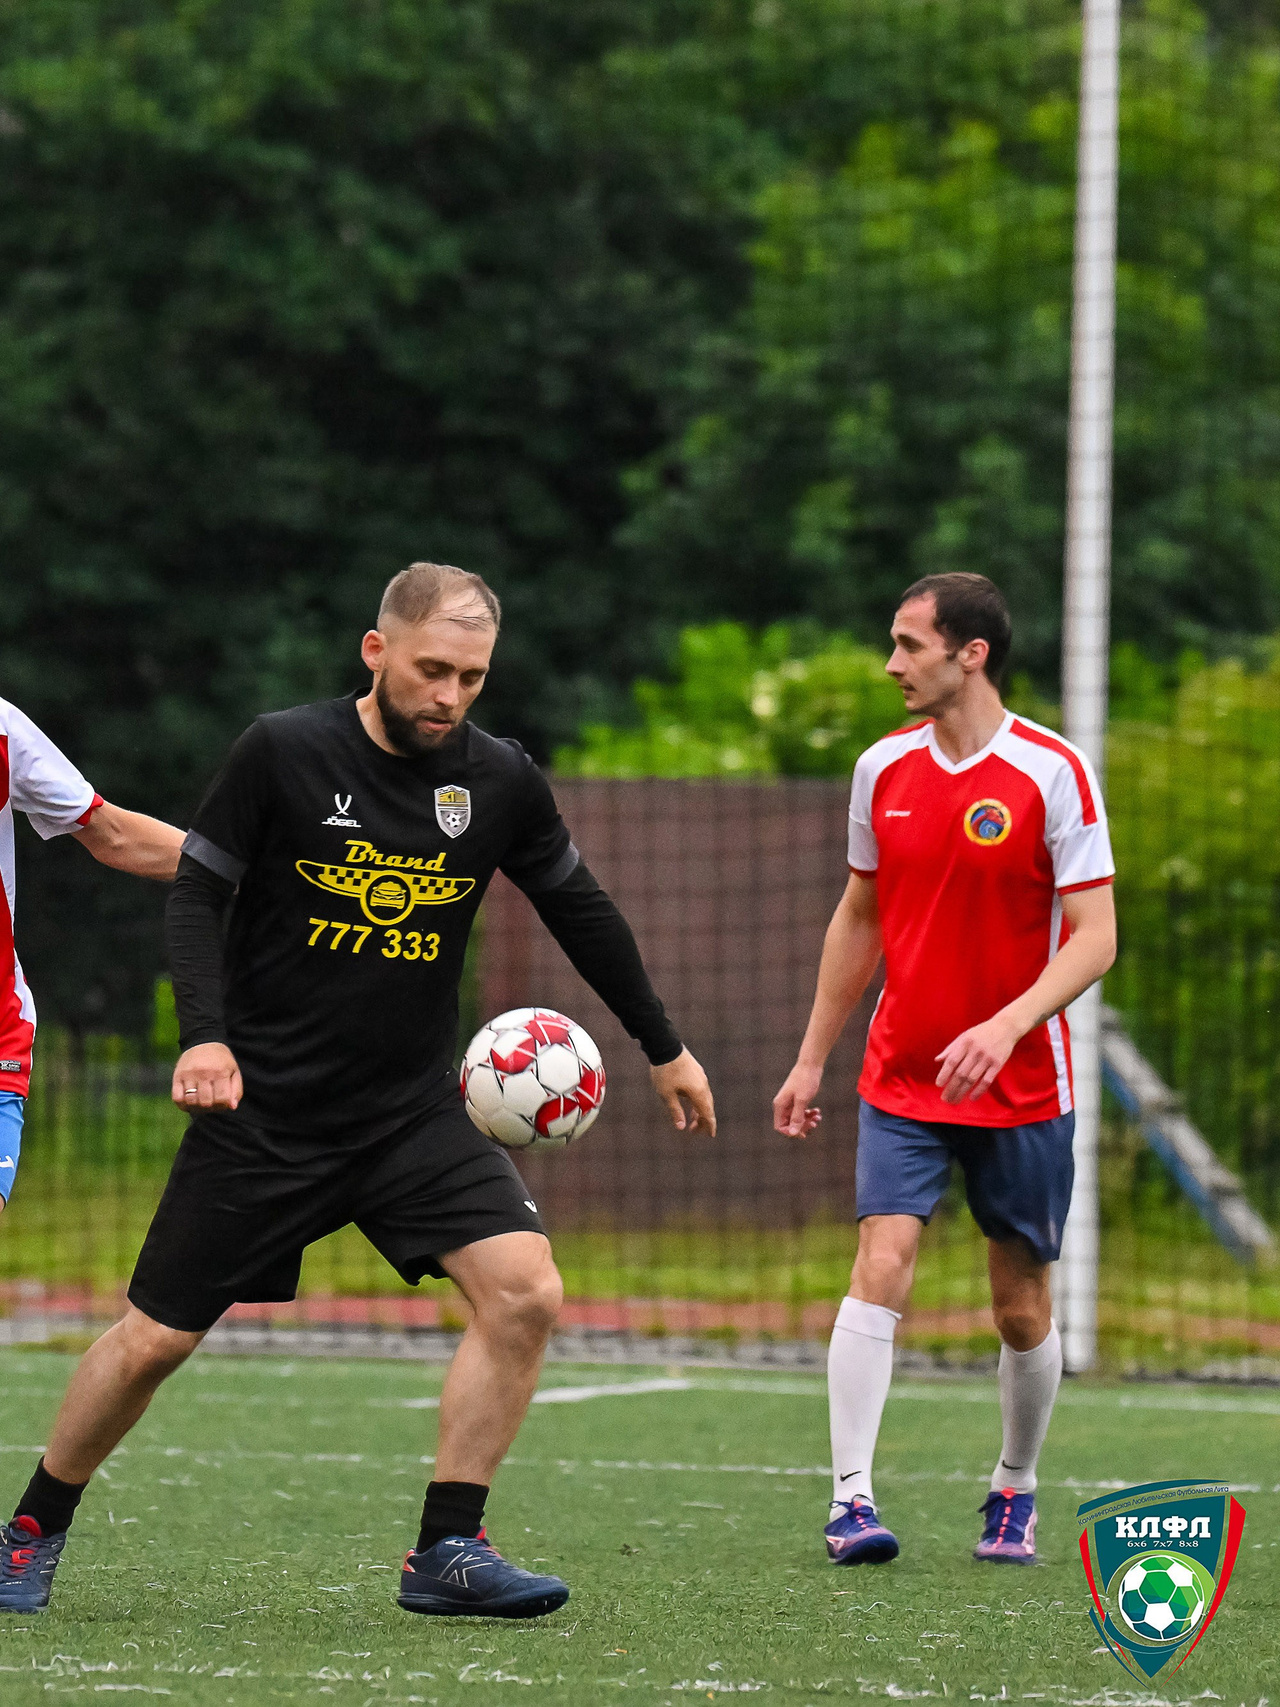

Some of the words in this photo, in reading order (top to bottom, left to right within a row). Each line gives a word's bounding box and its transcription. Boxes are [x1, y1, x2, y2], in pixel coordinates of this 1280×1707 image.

[344, 839, 447, 872] Brand
[307, 917, 373, 954] 777
[381, 928, 441, 962] 333
